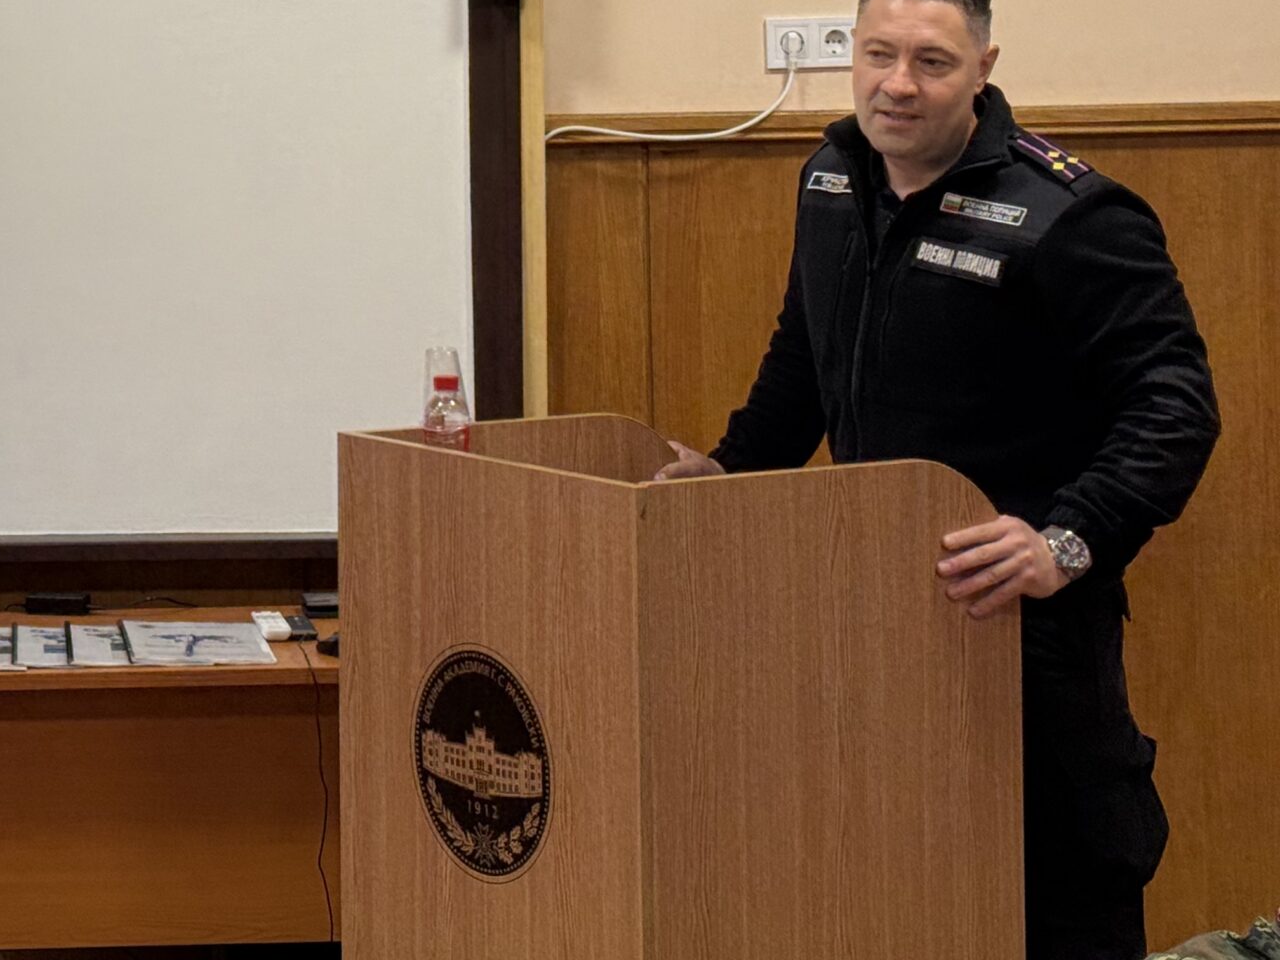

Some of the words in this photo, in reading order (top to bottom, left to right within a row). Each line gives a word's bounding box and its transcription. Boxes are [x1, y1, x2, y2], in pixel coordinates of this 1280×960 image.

[916, 241, 955, 267] ВОЕННА
[952, 250, 1001, 278] ПОЛИЦИЯ
[504, 681, 540, 748] РАКОВСКИ
[466, 799, 500, 820] 1912
